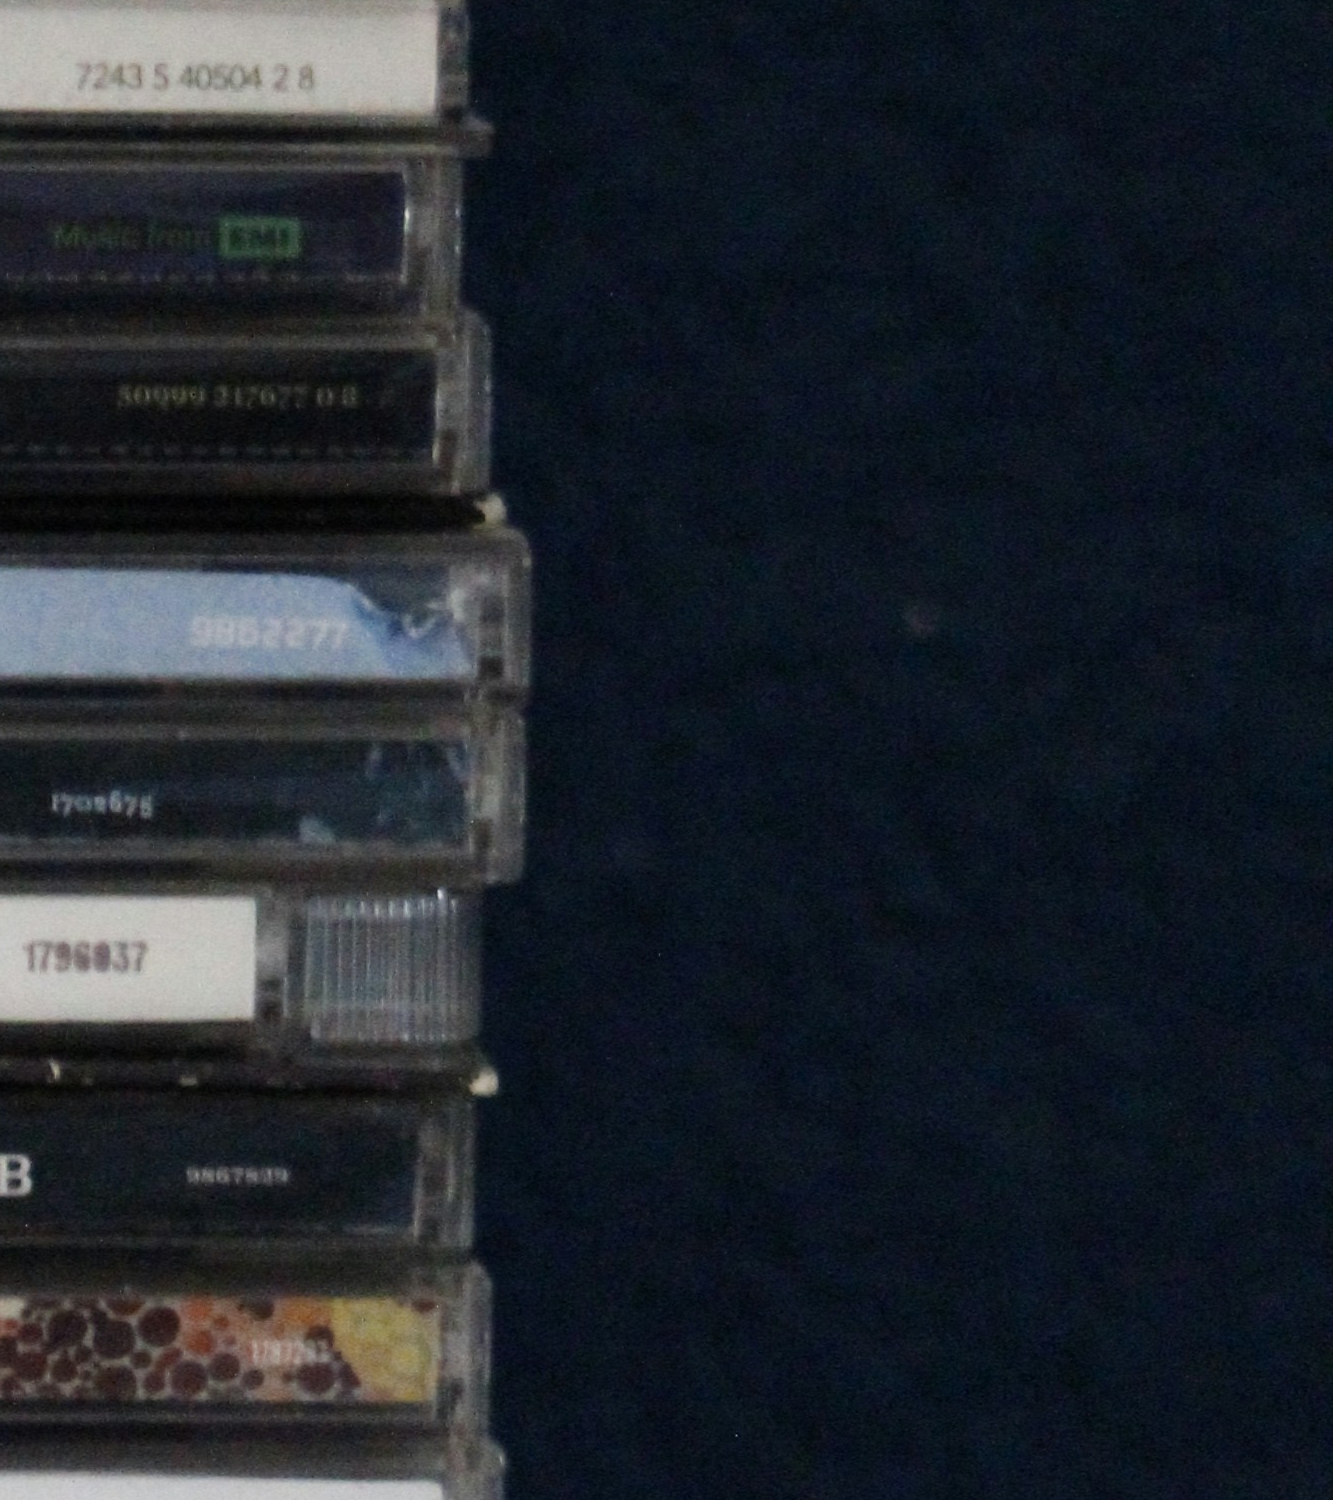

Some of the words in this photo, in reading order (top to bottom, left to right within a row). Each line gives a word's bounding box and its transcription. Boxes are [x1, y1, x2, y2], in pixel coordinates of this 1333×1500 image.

[75, 63, 143, 92] 7243
[151, 63, 169, 92] 5
[177, 63, 261, 92] 40504
[271, 63, 289, 92] 2
[297, 63, 316, 92] 8
[189, 614, 348, 648] 9862277
